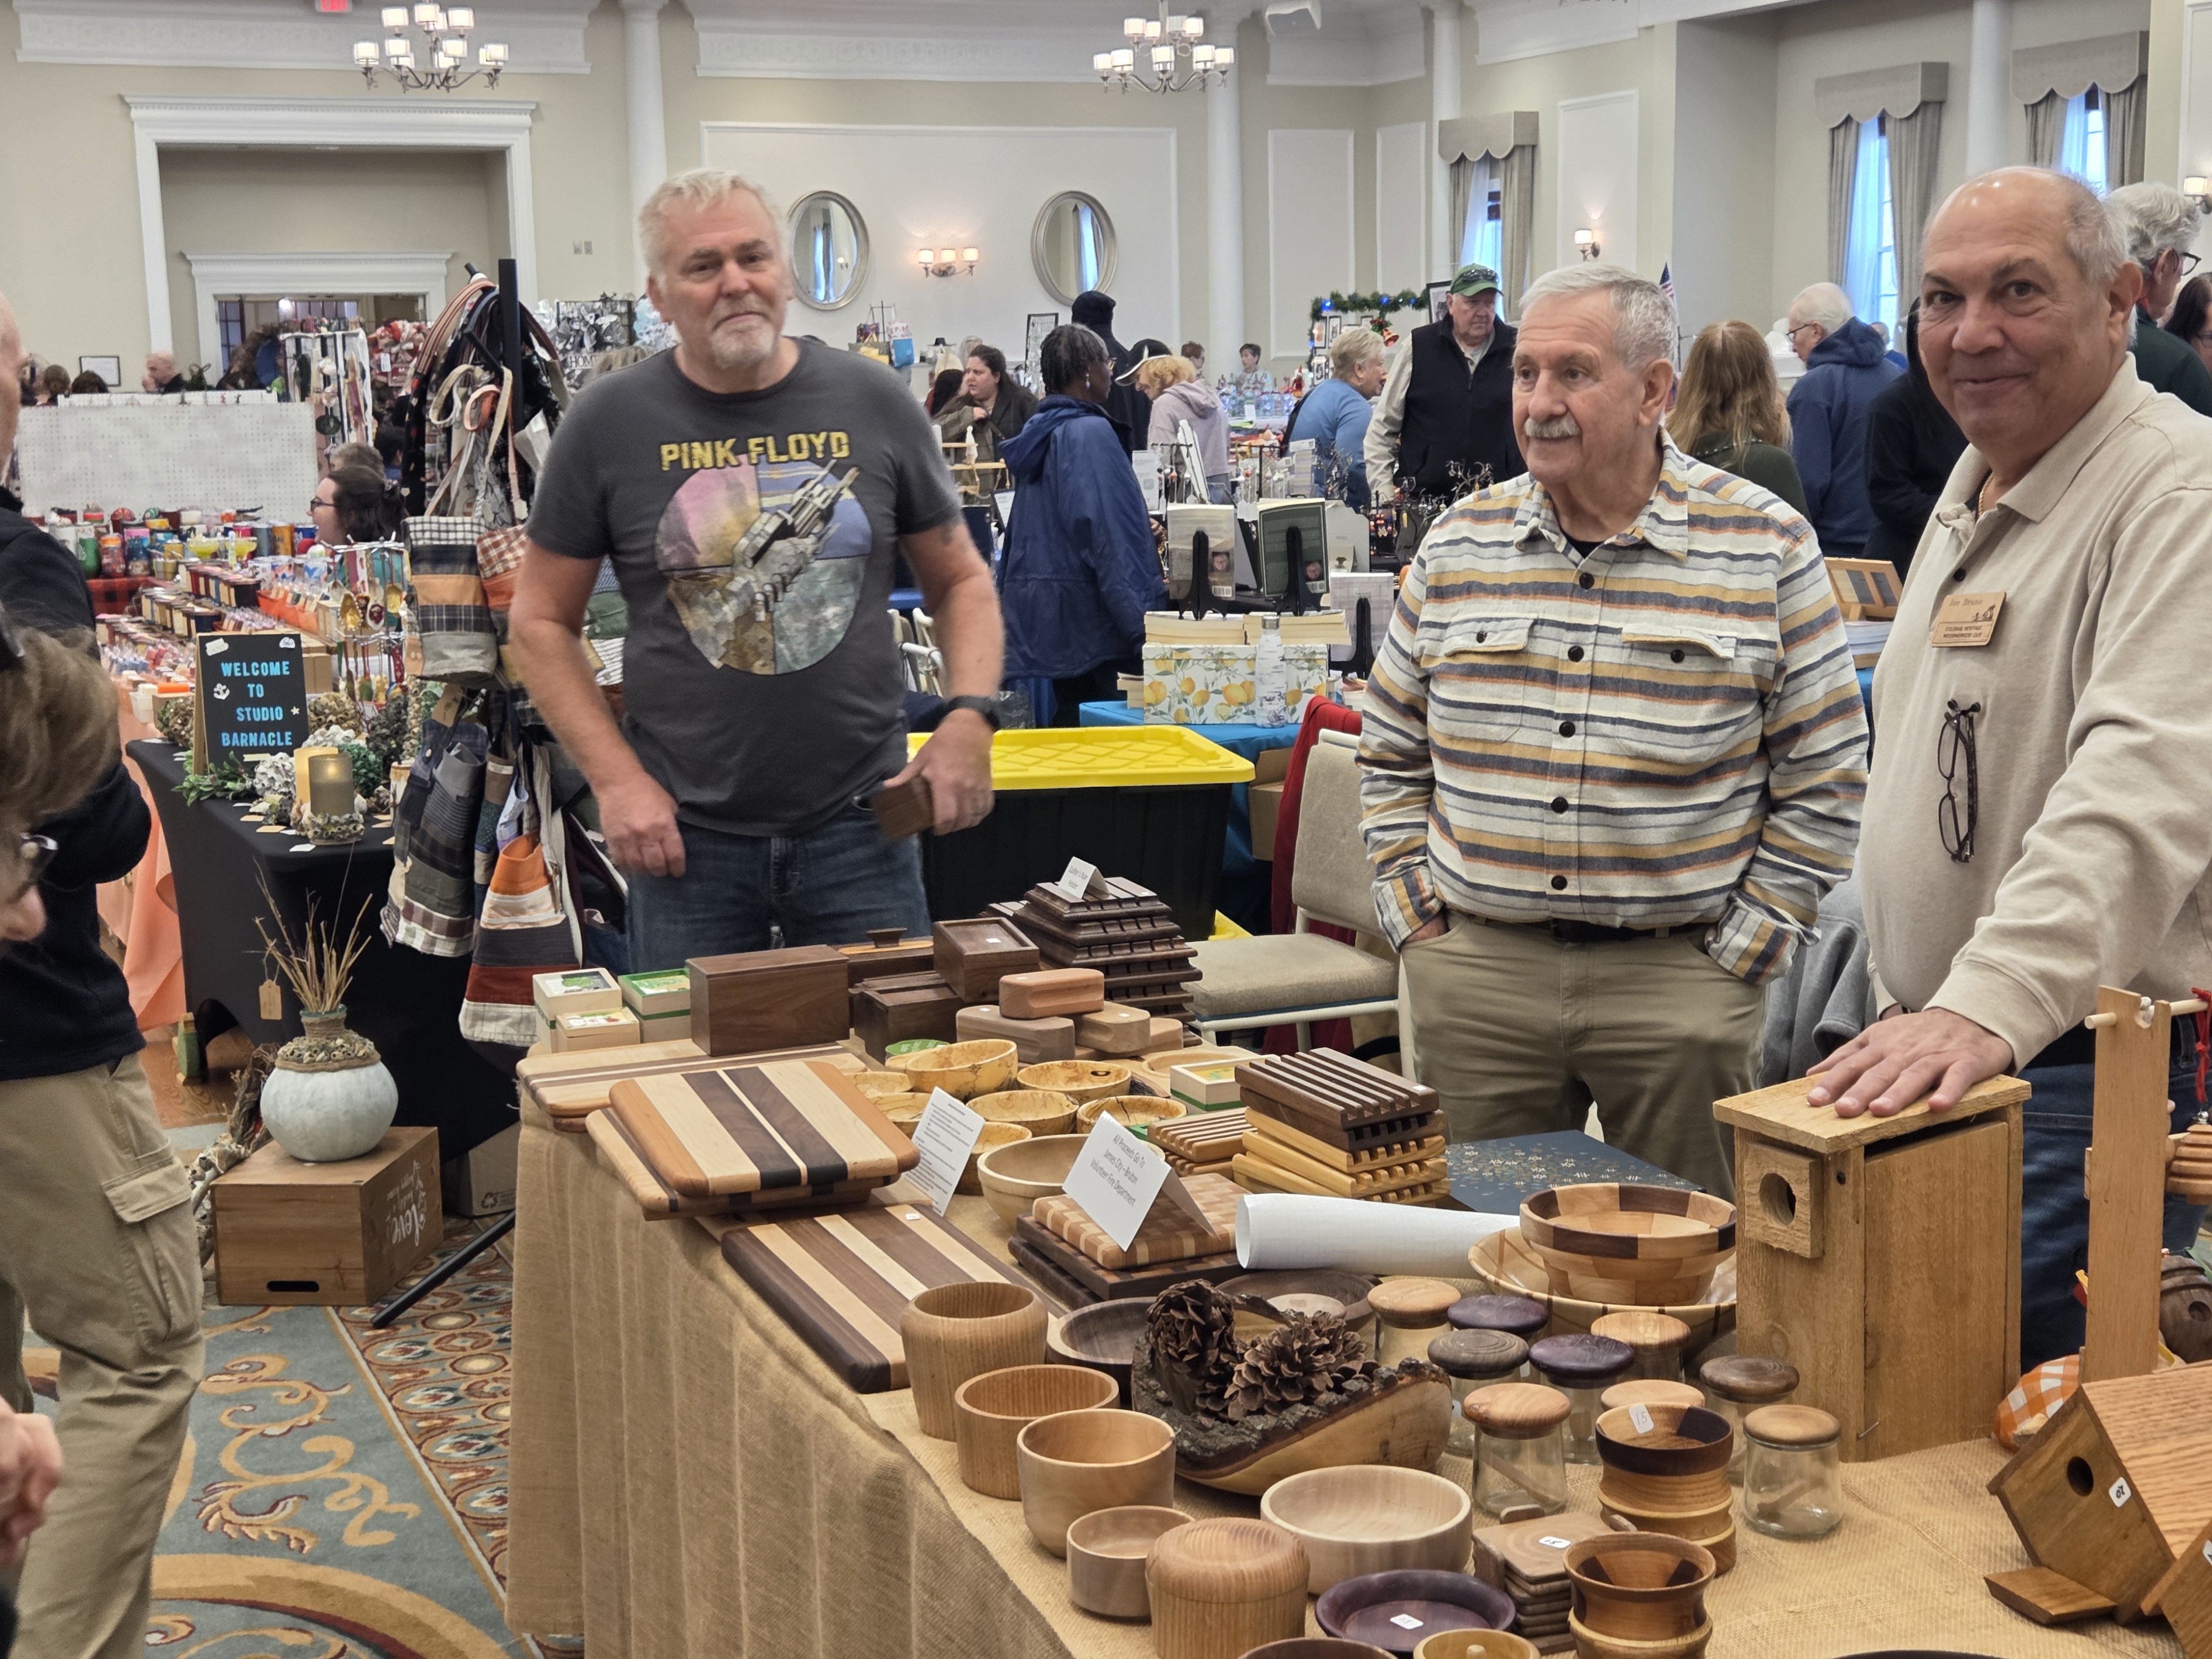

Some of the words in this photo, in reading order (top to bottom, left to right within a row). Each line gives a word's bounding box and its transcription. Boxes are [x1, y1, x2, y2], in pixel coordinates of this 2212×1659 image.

[660, 439, 741, 471] PINK
[748, 431, 851, 465] FLOYD
[221, 661, 290, 676] WELCOME
[247, 684, 264, 698] TO
[236, 706, 283, 722] STUDIO
[221, 731, 293, 747] BARNACLE
[1112, 1134, 1121, 1144] All
[1118, 1138, 1135, 1159] Proceeds
[1133, 1152, 1140, 1164] Go
[1139, 1156, 1145, 1168] To
[1103, 1148, 1117, 1165] James
[1114, 1158, 1124, 1173] City
[1124, 1166, 1138, 1185] Bruton
[1091, 1157, 1109, 1180] Volunteer
[1107, 1173, 1115, 1187] Fire
[1113, 1180, 1136, 1207] Department
[1636, 1410, 1647, 1426] 15
